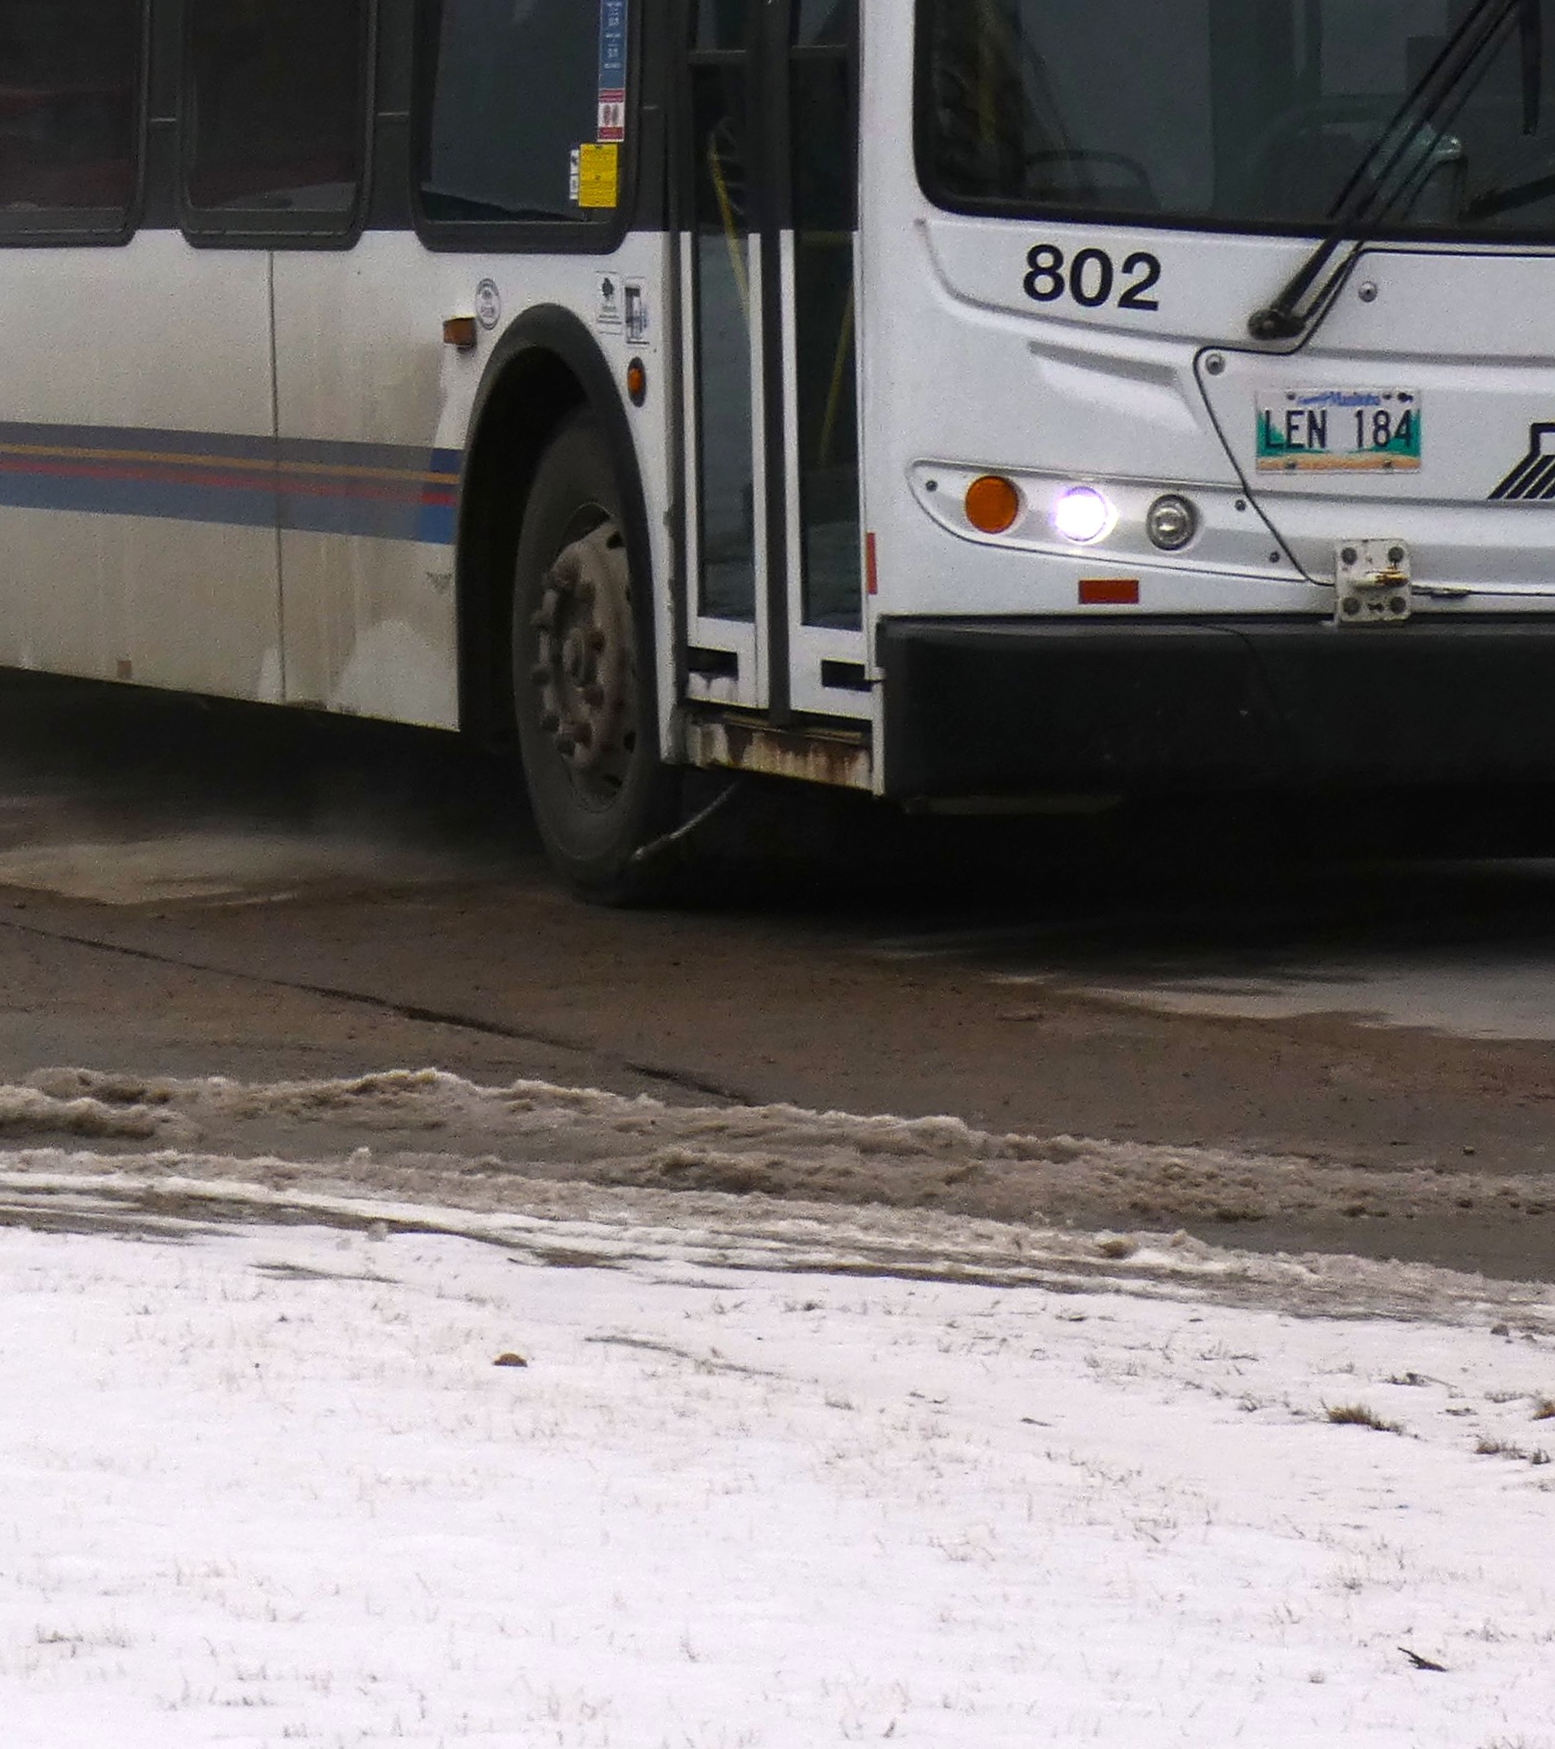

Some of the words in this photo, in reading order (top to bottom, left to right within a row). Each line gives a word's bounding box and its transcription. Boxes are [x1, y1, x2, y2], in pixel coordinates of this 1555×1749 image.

[1023, 243, 1162, 311] 802
[1264, 409, 1327, 449] LEN
[1355, 409, 1412, 449] 184
